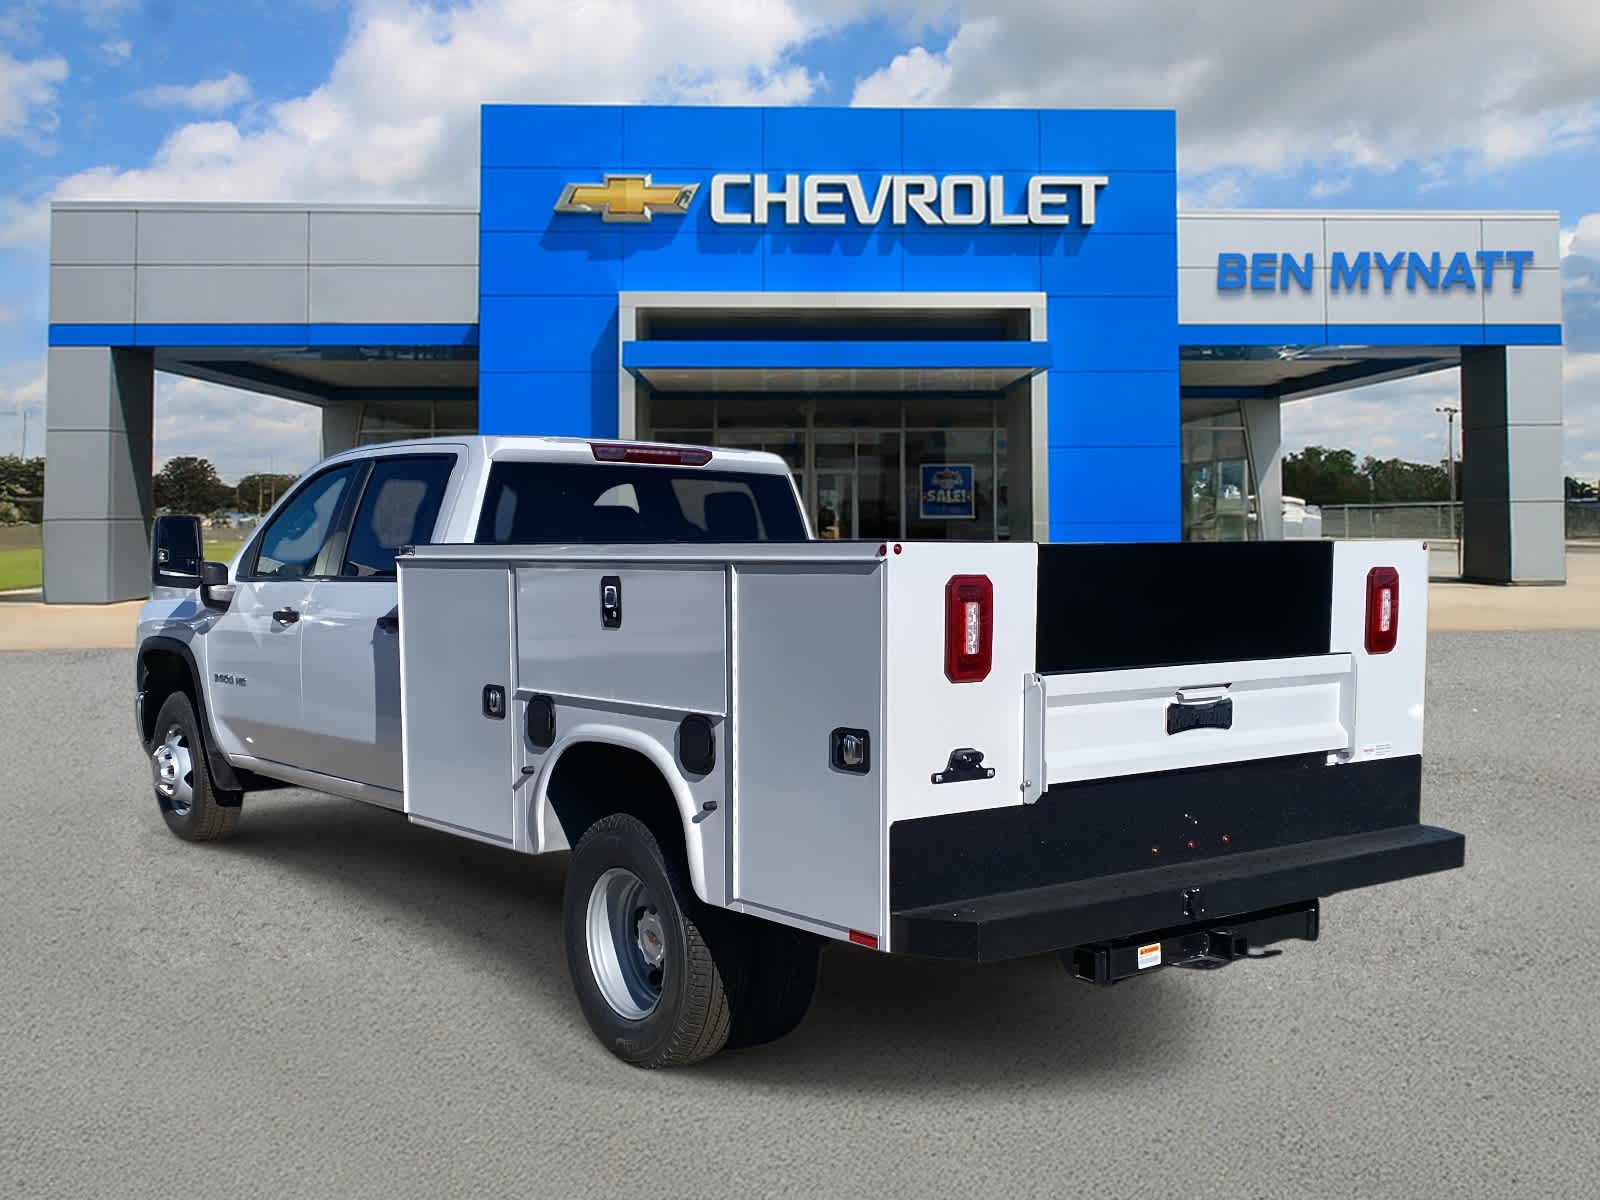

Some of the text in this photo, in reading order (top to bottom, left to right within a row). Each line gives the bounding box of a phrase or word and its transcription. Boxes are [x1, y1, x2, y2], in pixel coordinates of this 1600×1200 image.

[710, 173, 1109, 225] CHEVROLET
[1217, 250, 1534, 291] BEN MYNATT
